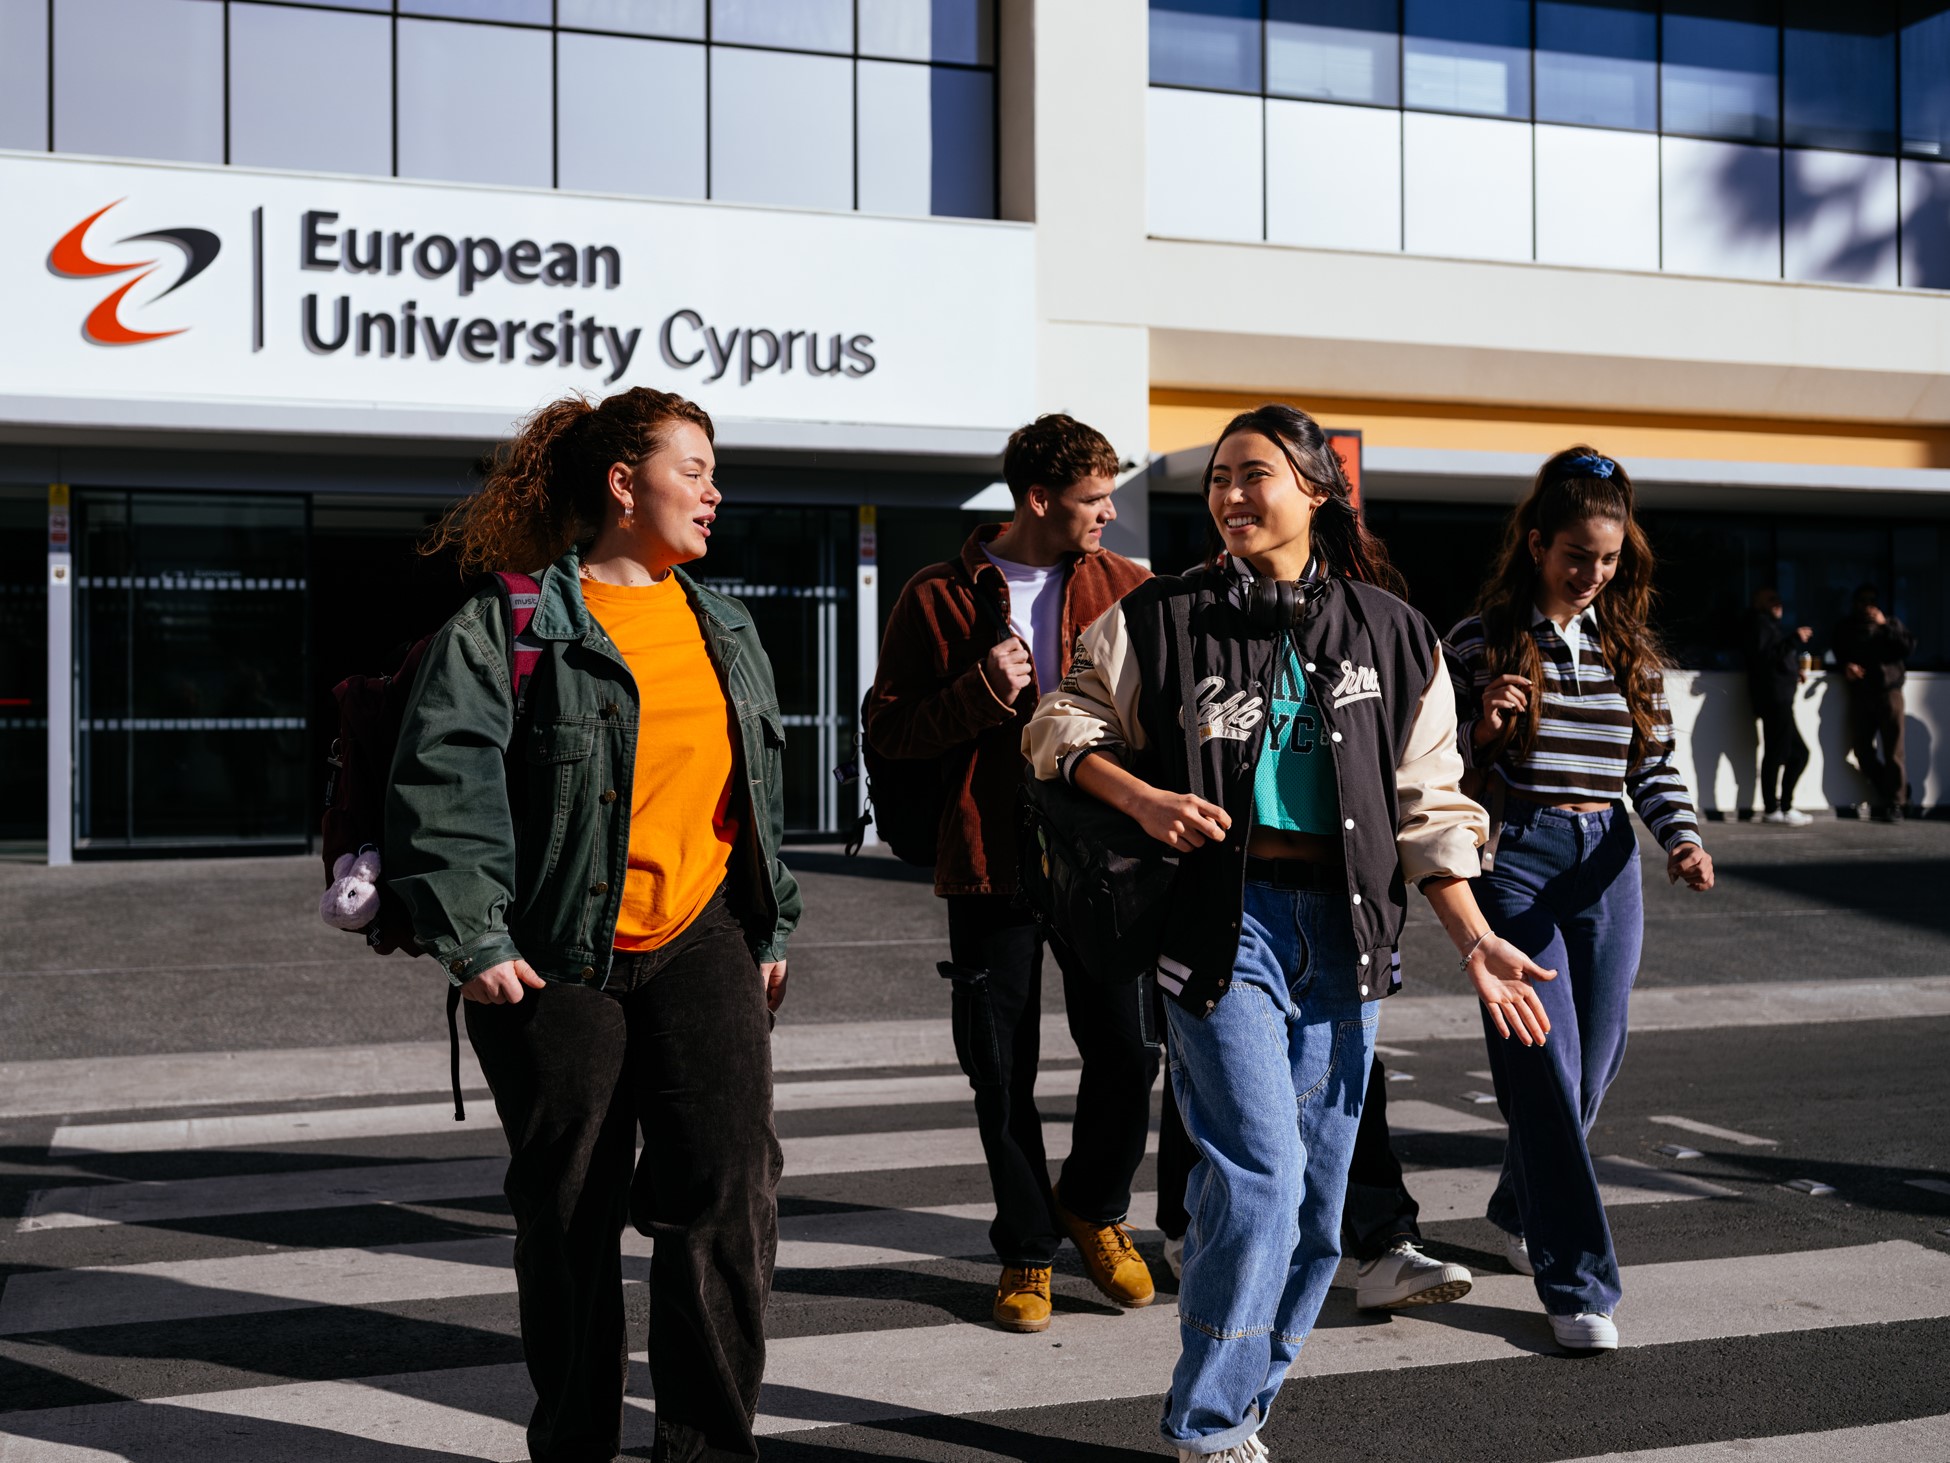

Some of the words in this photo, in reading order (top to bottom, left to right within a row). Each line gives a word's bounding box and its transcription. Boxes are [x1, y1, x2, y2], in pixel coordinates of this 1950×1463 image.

[300, 209, 622, 297] European
[302, 293, 641, 385] University
[659, 308, 877, 386] Cyprus
